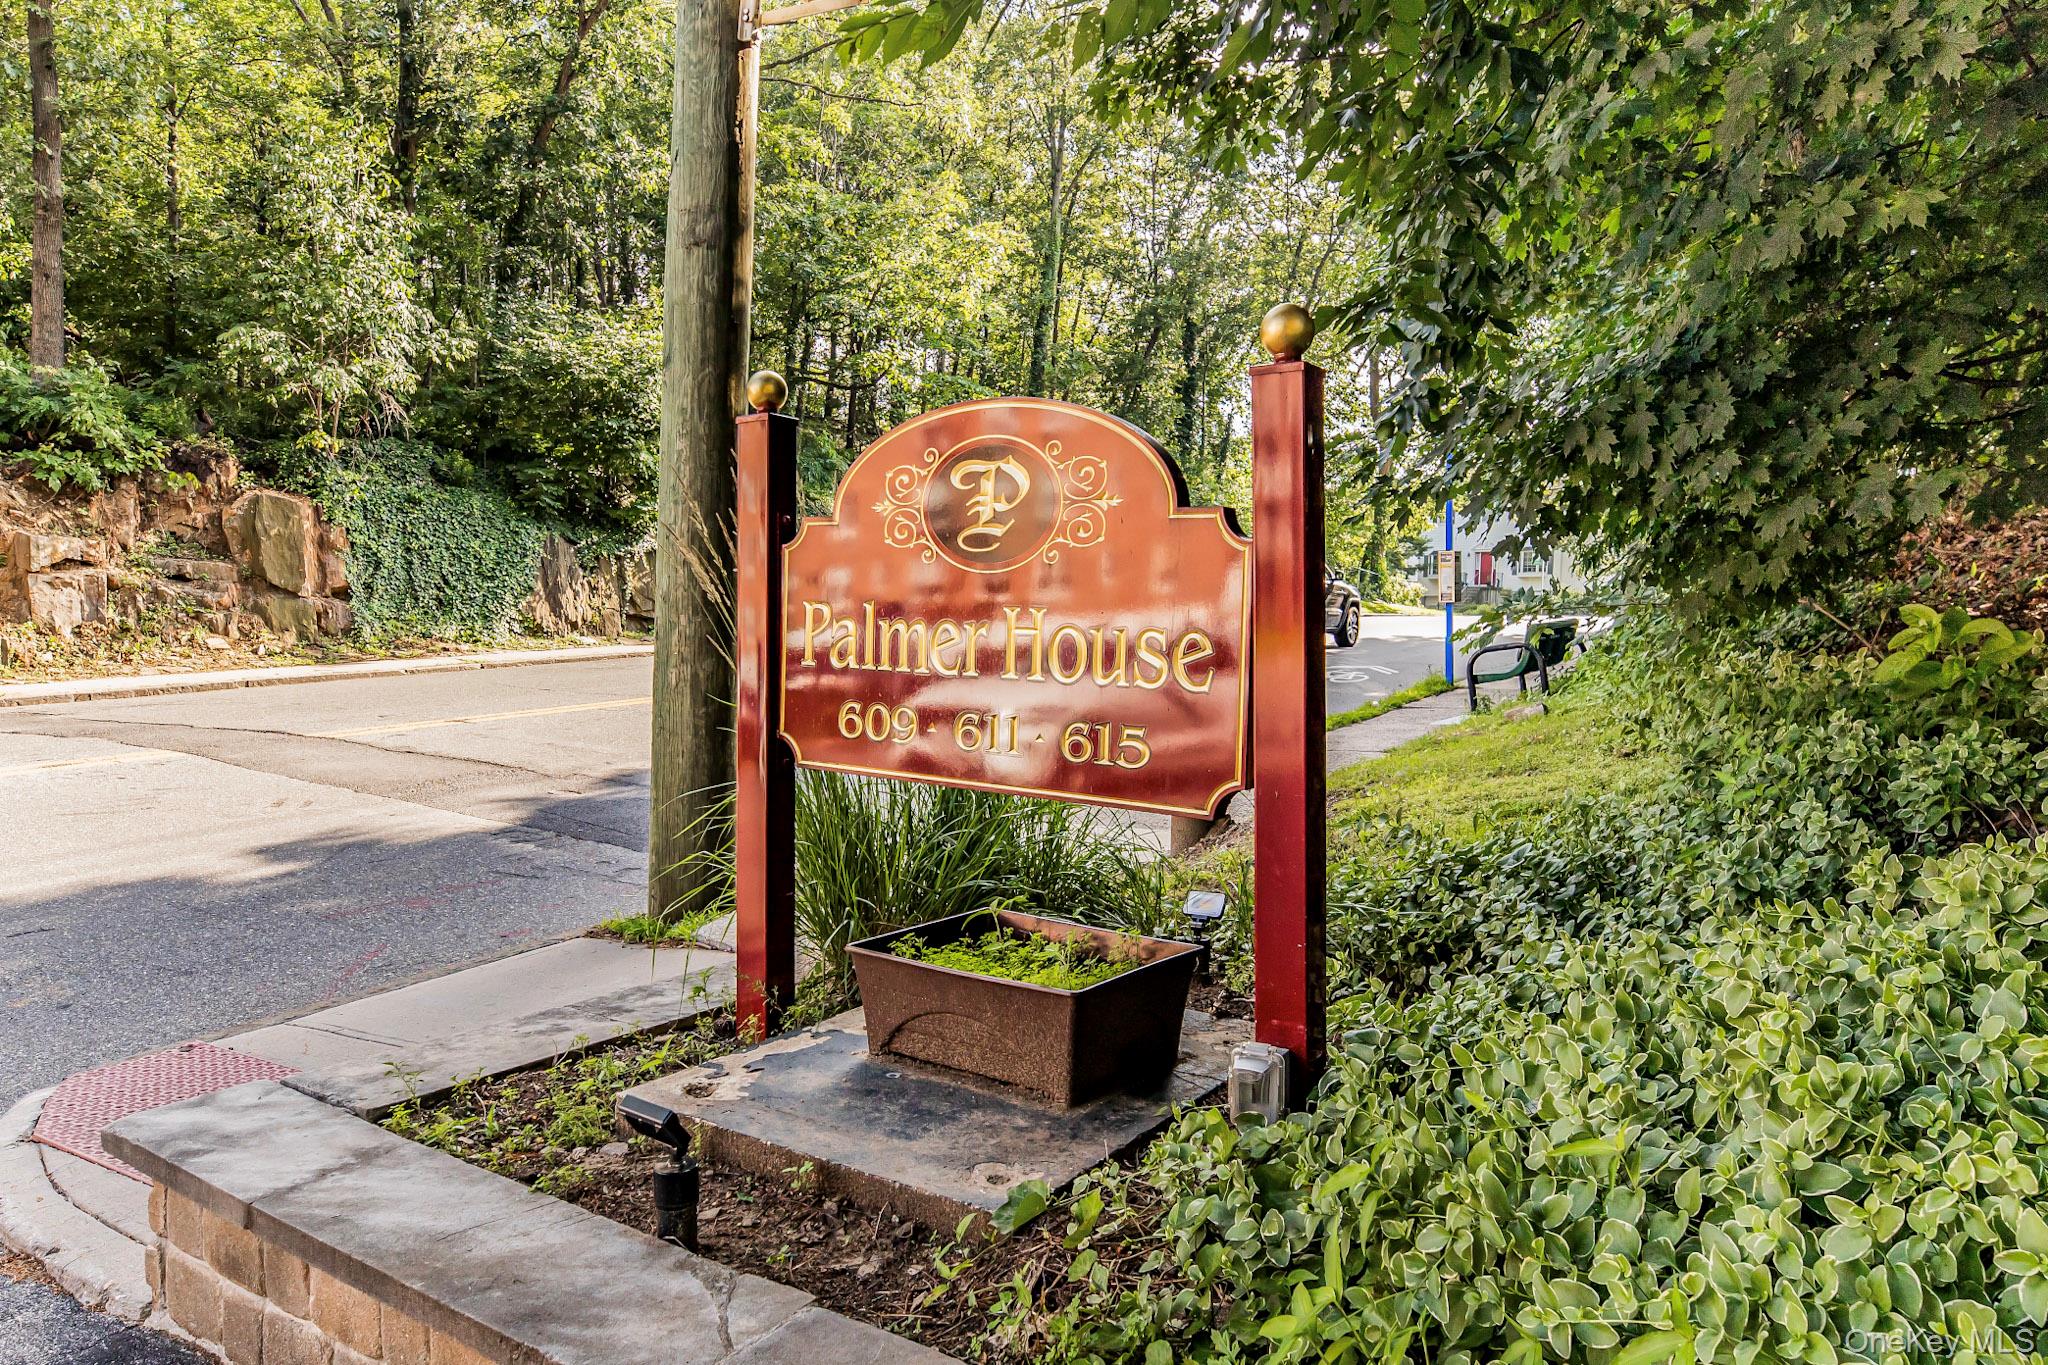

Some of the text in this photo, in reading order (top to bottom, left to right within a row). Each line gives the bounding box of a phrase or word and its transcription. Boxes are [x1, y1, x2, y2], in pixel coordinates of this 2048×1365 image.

[950, 455, 1031, 552] P
[800, 600, 1215, 693] Palmer House
[837, 700, 1151, 769] 609 611 615
